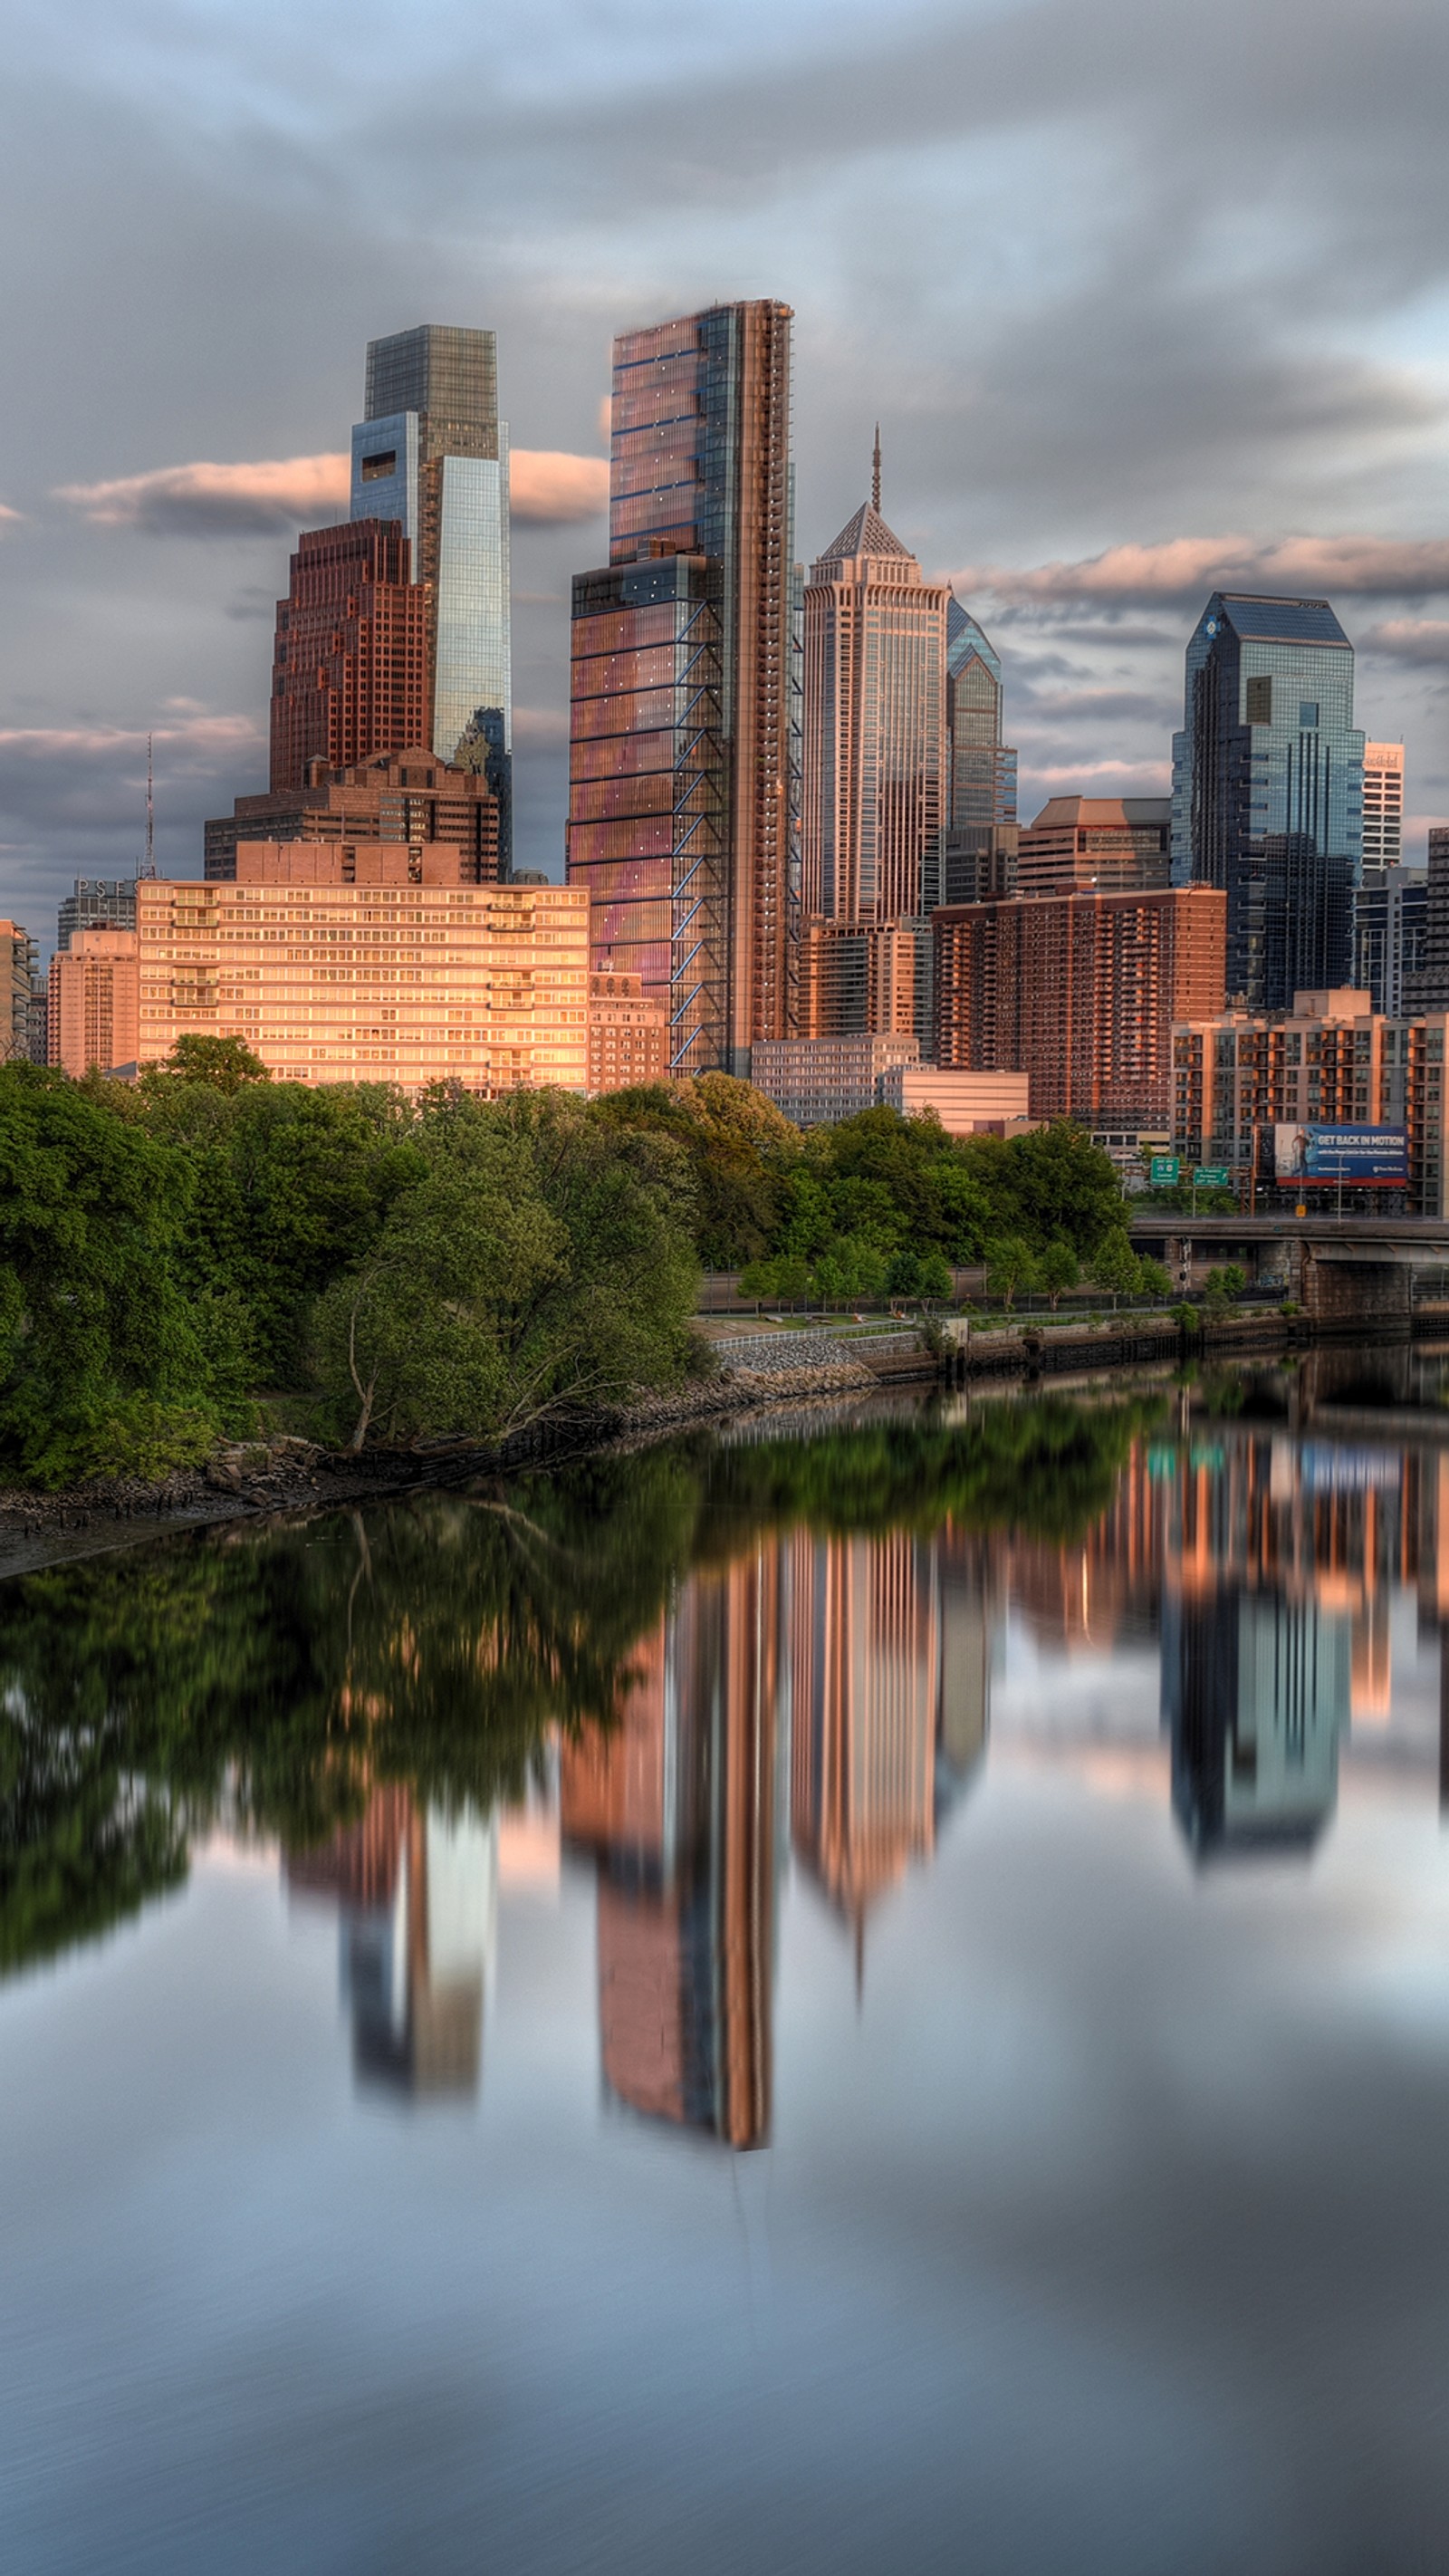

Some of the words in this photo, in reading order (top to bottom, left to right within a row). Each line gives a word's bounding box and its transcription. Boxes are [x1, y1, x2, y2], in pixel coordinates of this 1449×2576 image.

[1318, 1135, 1335, 1145] GET
[1336, 1135, 1359, 1146] BACK
[1361, 1136, 1370, 1146] IN
[1371, 1136, 1405, 1146] MOTION
